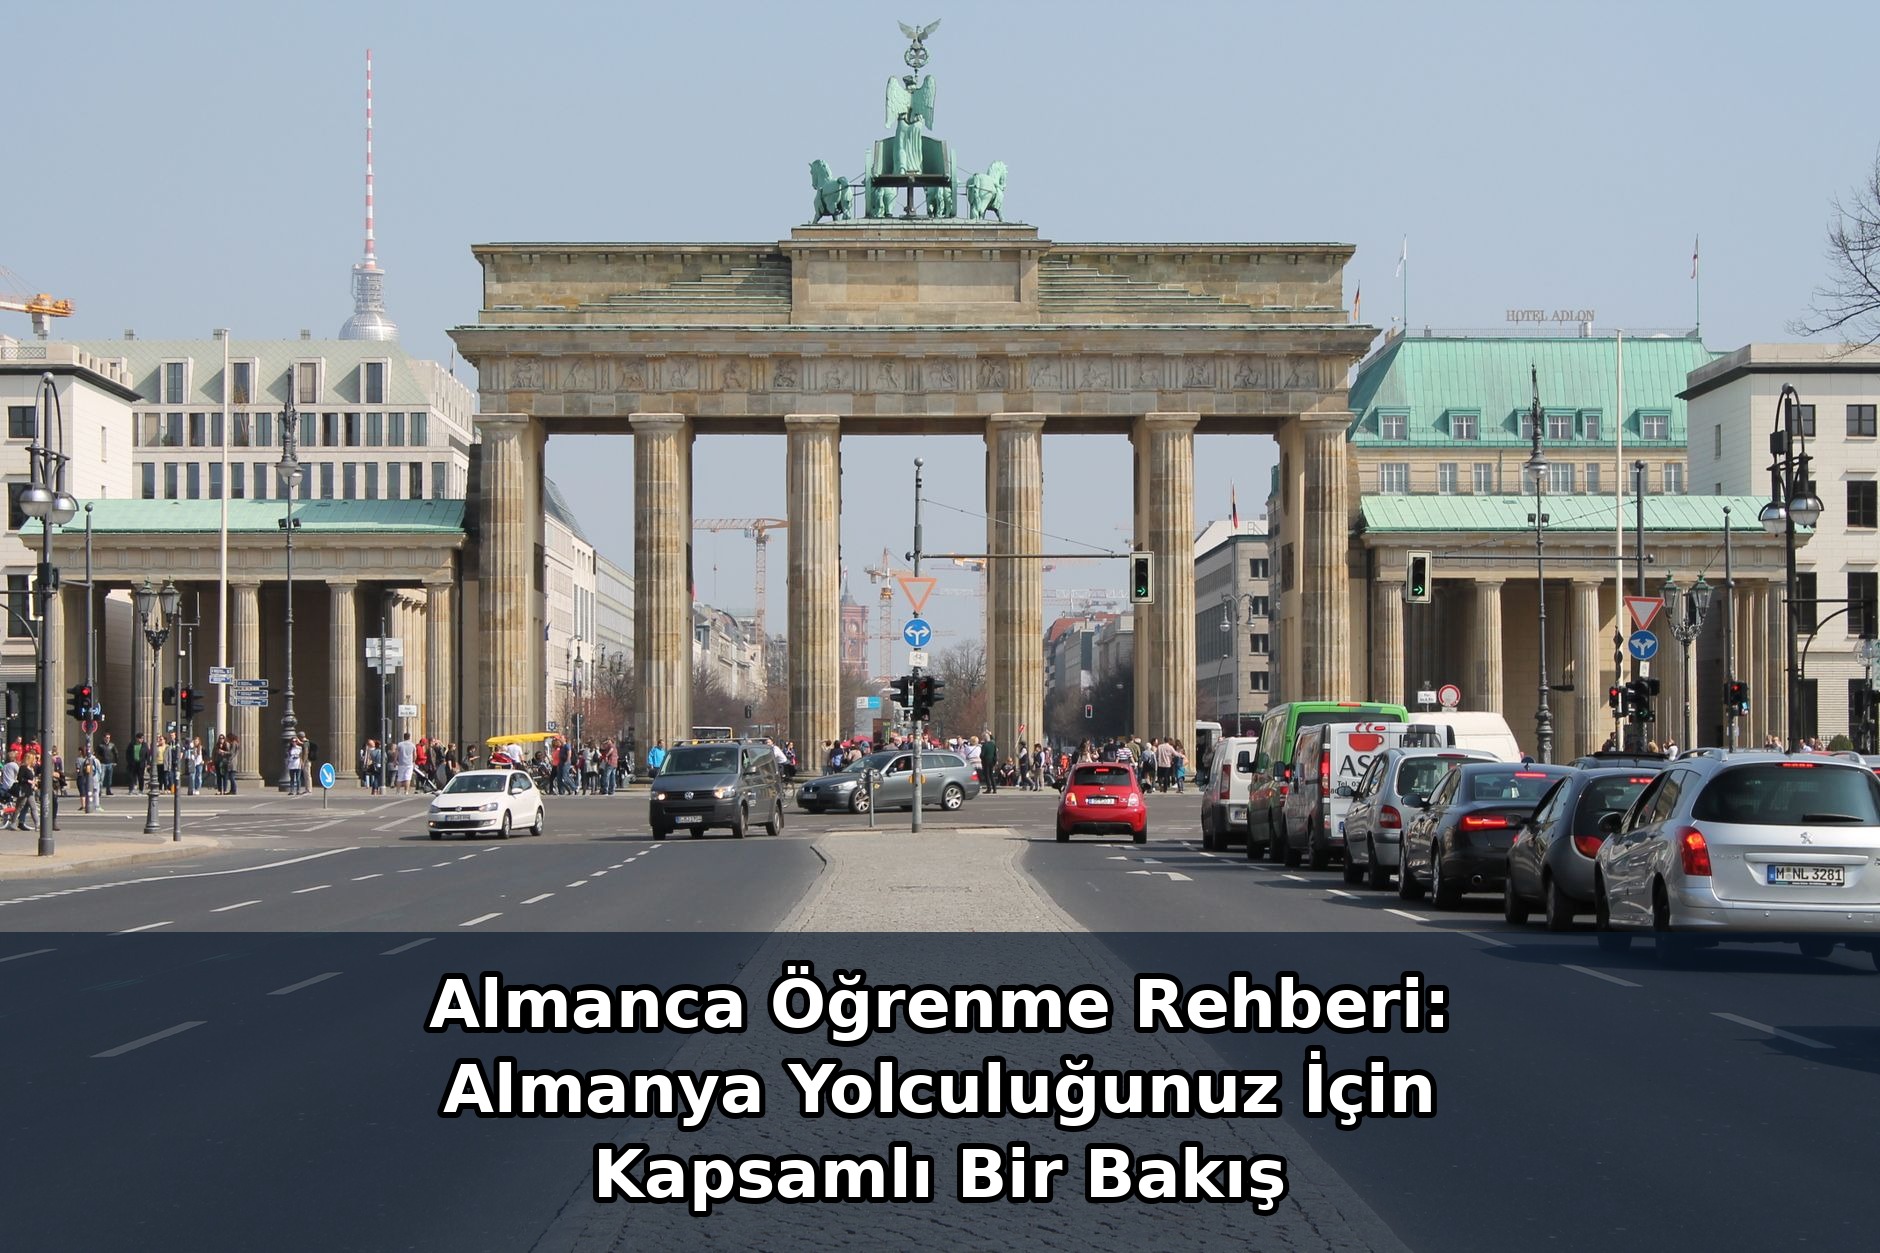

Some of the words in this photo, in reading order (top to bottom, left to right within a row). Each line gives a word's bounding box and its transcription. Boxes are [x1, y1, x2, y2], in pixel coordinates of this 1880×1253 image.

[1506, 310, 1547, 321] HOTEL
[1551, 310, 1594, 321] ADLON
[1776, 867, 1785, 880] M
[1792, 868, 1809, 880] NL
[1812, 869, 1842, 881] 3281
